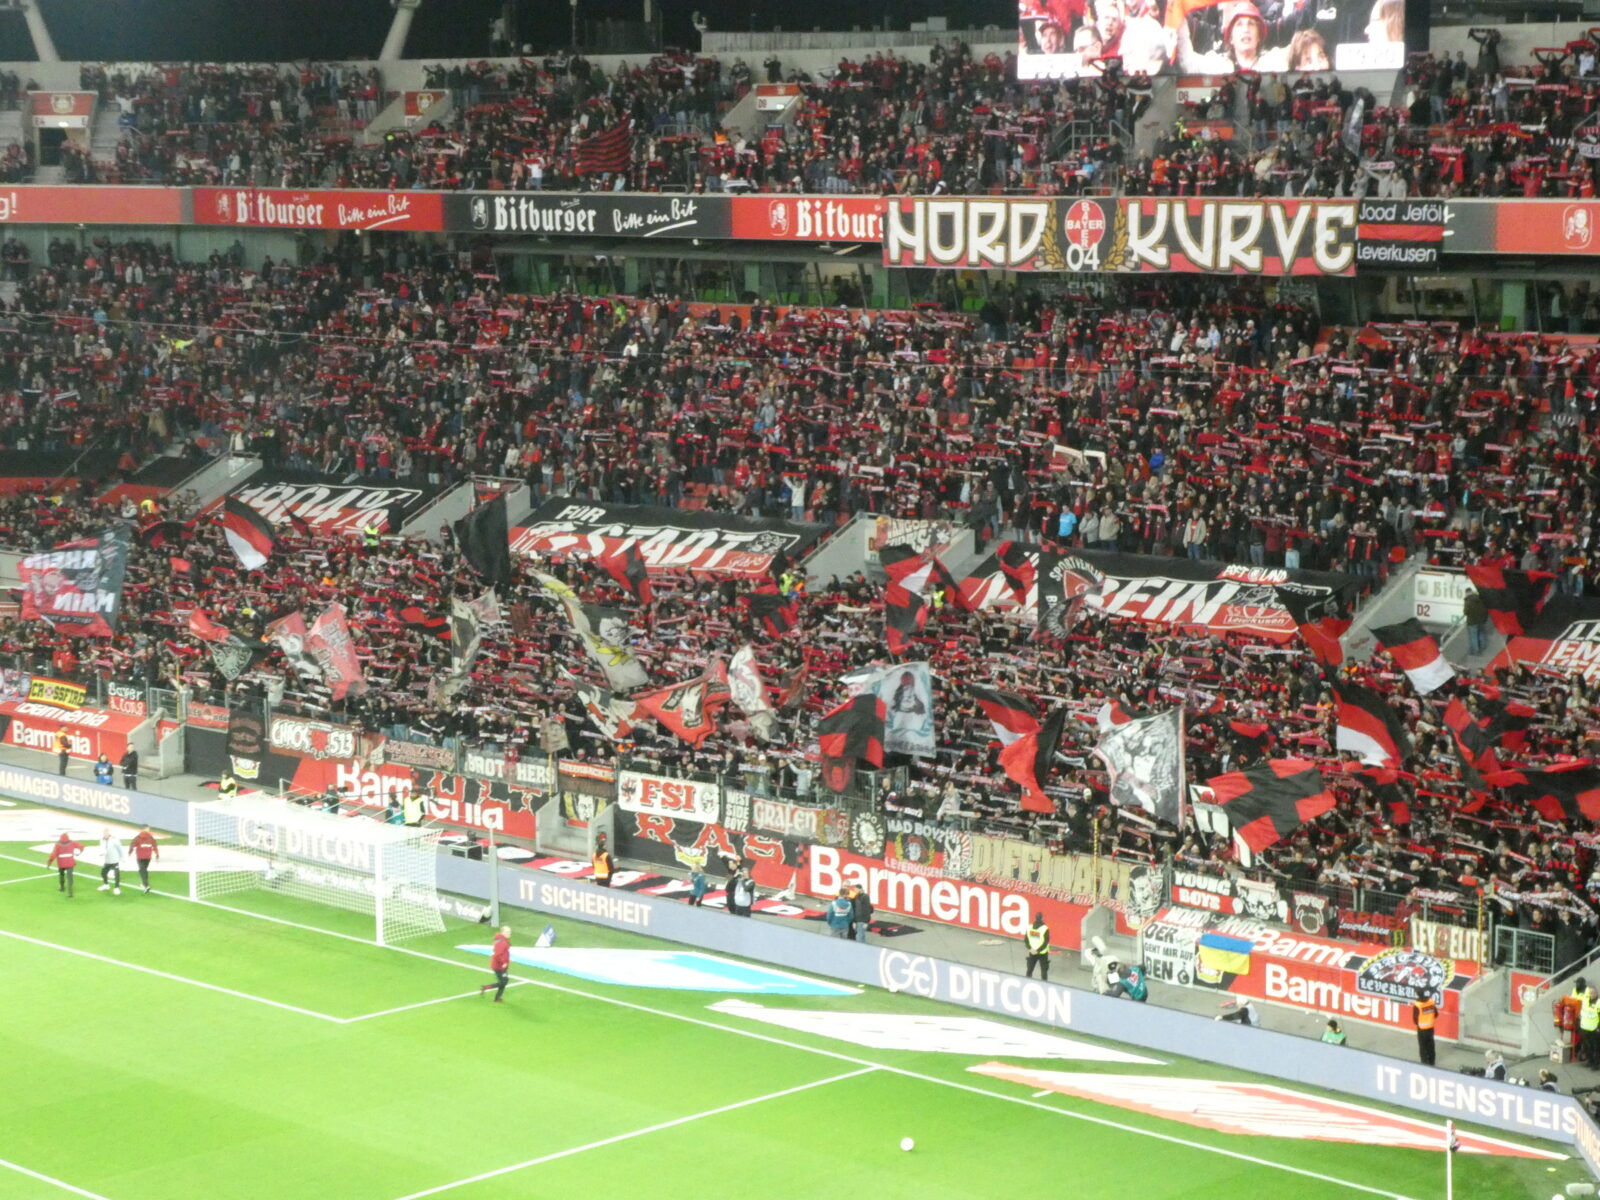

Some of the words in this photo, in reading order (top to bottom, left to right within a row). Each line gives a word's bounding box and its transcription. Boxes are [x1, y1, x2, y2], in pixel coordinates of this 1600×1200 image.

[236, 191, 325, 226] Bitburger
[494, 198, 596, 233] Bitburger
[613, 208, 644, 233] Bitte
[645, 209, 670, 226] ein
[670, 199, 698, 220] Bit
[1127, 201, 1355, 274] KURVE
[1357, 243, 1437, 264] Leverkusen
[1065, 243, 1100, 272] 04
[555, 504, 607, 522] FÜR
[1433, 578, 1465, 598] Bitb
[1416, 604, 1430, 617] D2
[12, 719, 91, 756] Barmnia
[62, 783, 131, 816] SERVICES
[336, 761, 504, 831] Barnia
[639, 778, 697, 813] FSI
[519, 878, 536, 903] IT
[540, 883, 652, 927] SICHERHEIT
[810, 844, 1029, 935] Barmenia
[1145, 922, 1179, 943] DER
[1145, 956, 1173, 981] DEN
[949, 965, 1072, 1026] DITCON
[1376, 1064, 1402, 1095] IT
